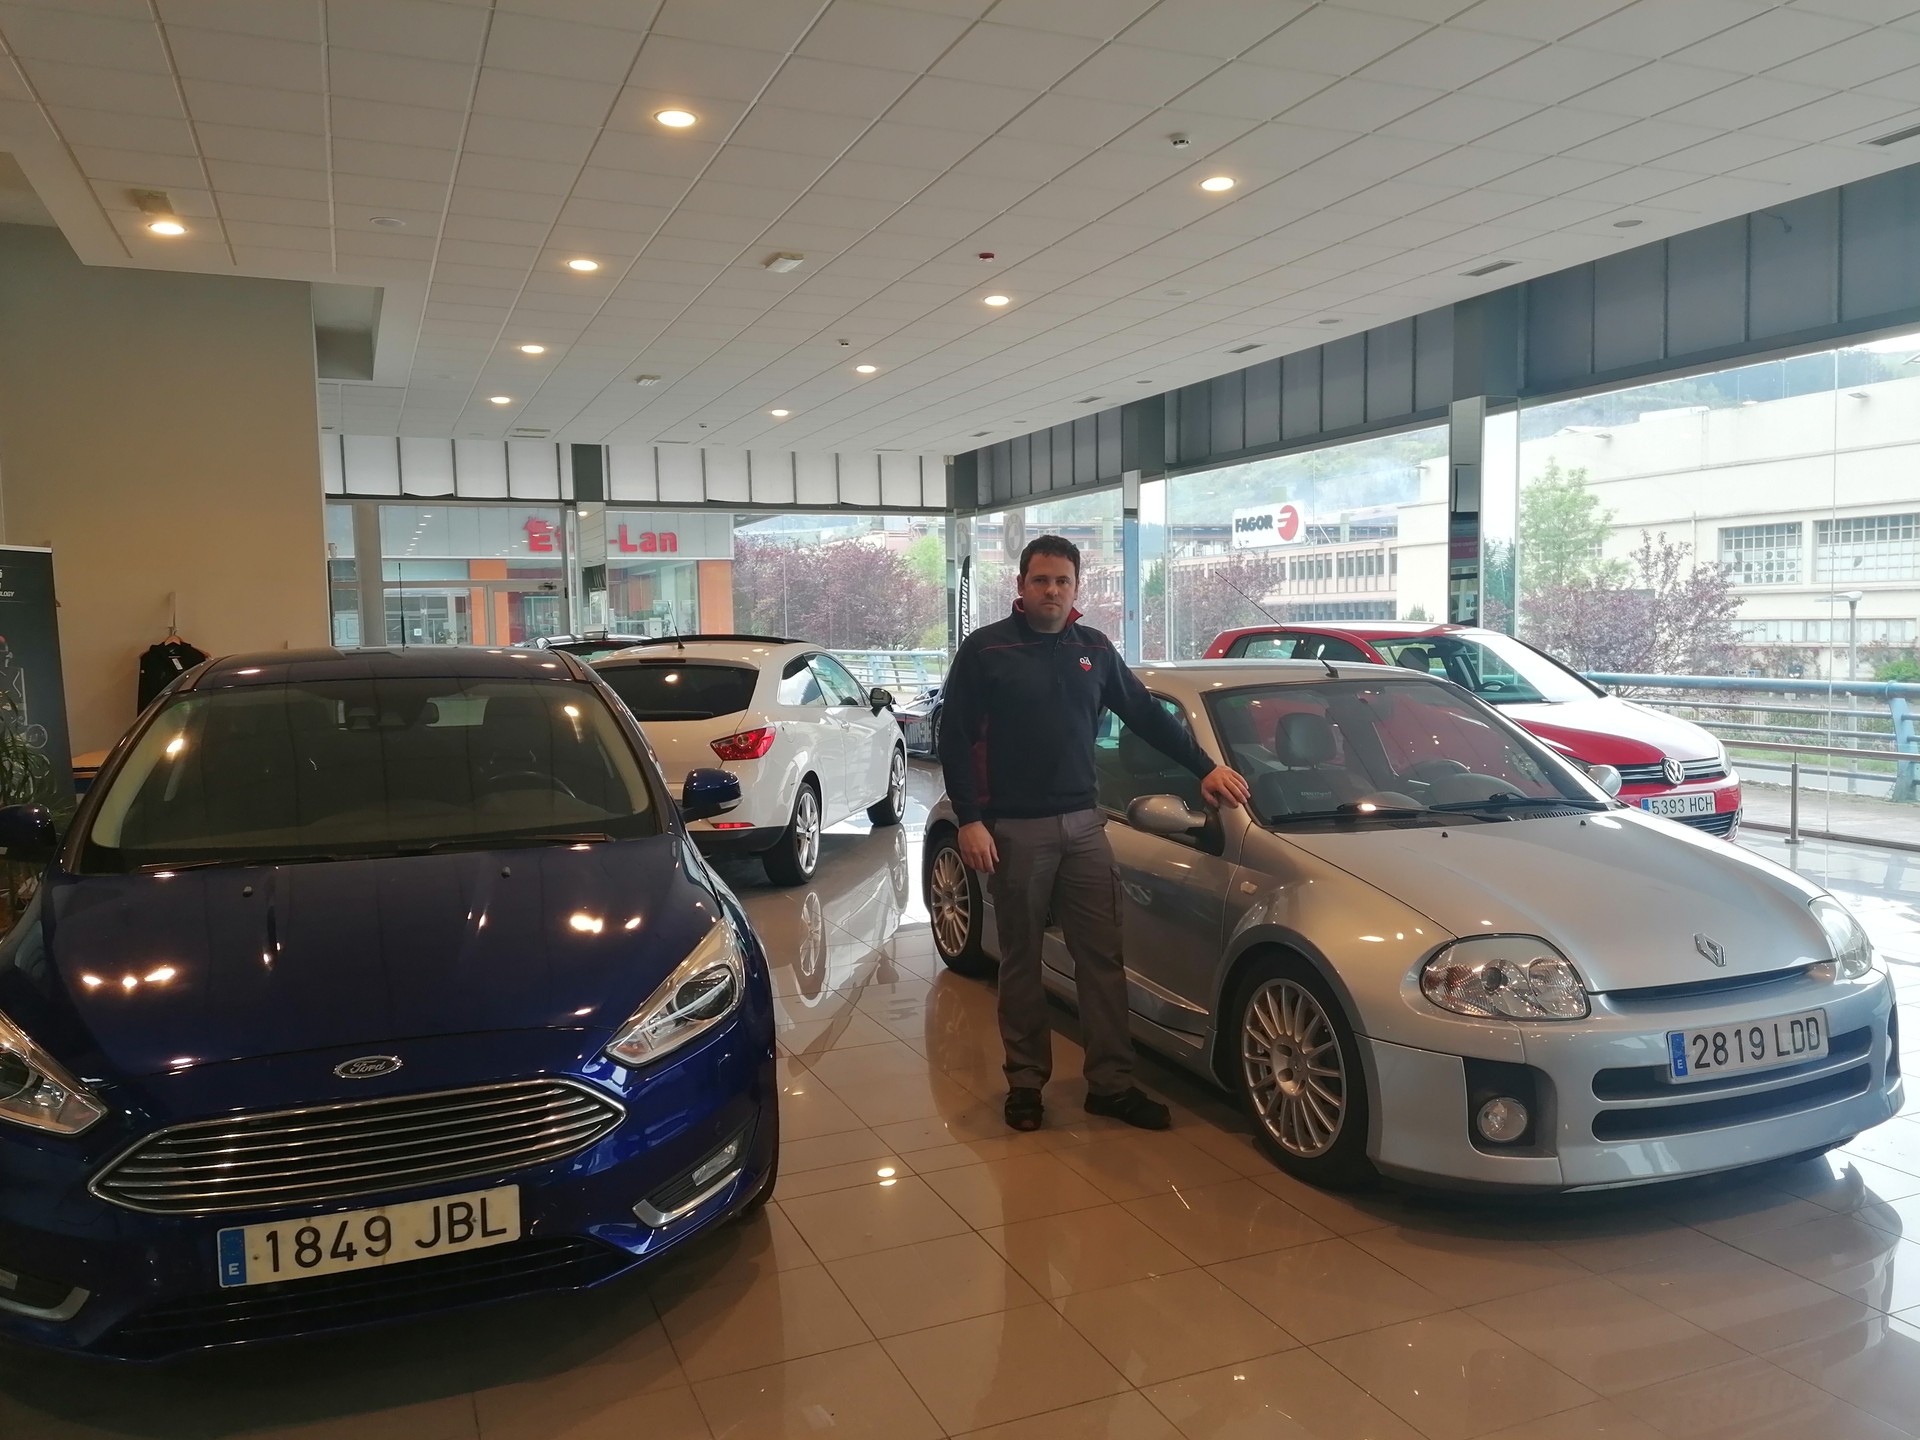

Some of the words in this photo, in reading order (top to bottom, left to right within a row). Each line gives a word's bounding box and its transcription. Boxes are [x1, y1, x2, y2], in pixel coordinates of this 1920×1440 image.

[1235, 514, 1273, 533] FAGOR
[1651, 798, 1685, 815] 5393
[1689, 795, 1713, 813] HCH
[1692, 1026, 1765, 1070] 2819
[1773, 1016, 1821, 1057] LDD
[350, 1060, 386, 1074] Ford
[1677, 1059, 1683, 1069] E
[265, 1215, 392, 1273] 1849
[414, 1197, 507, 1249] JBL
[228, 1262, 240, 1276] E
